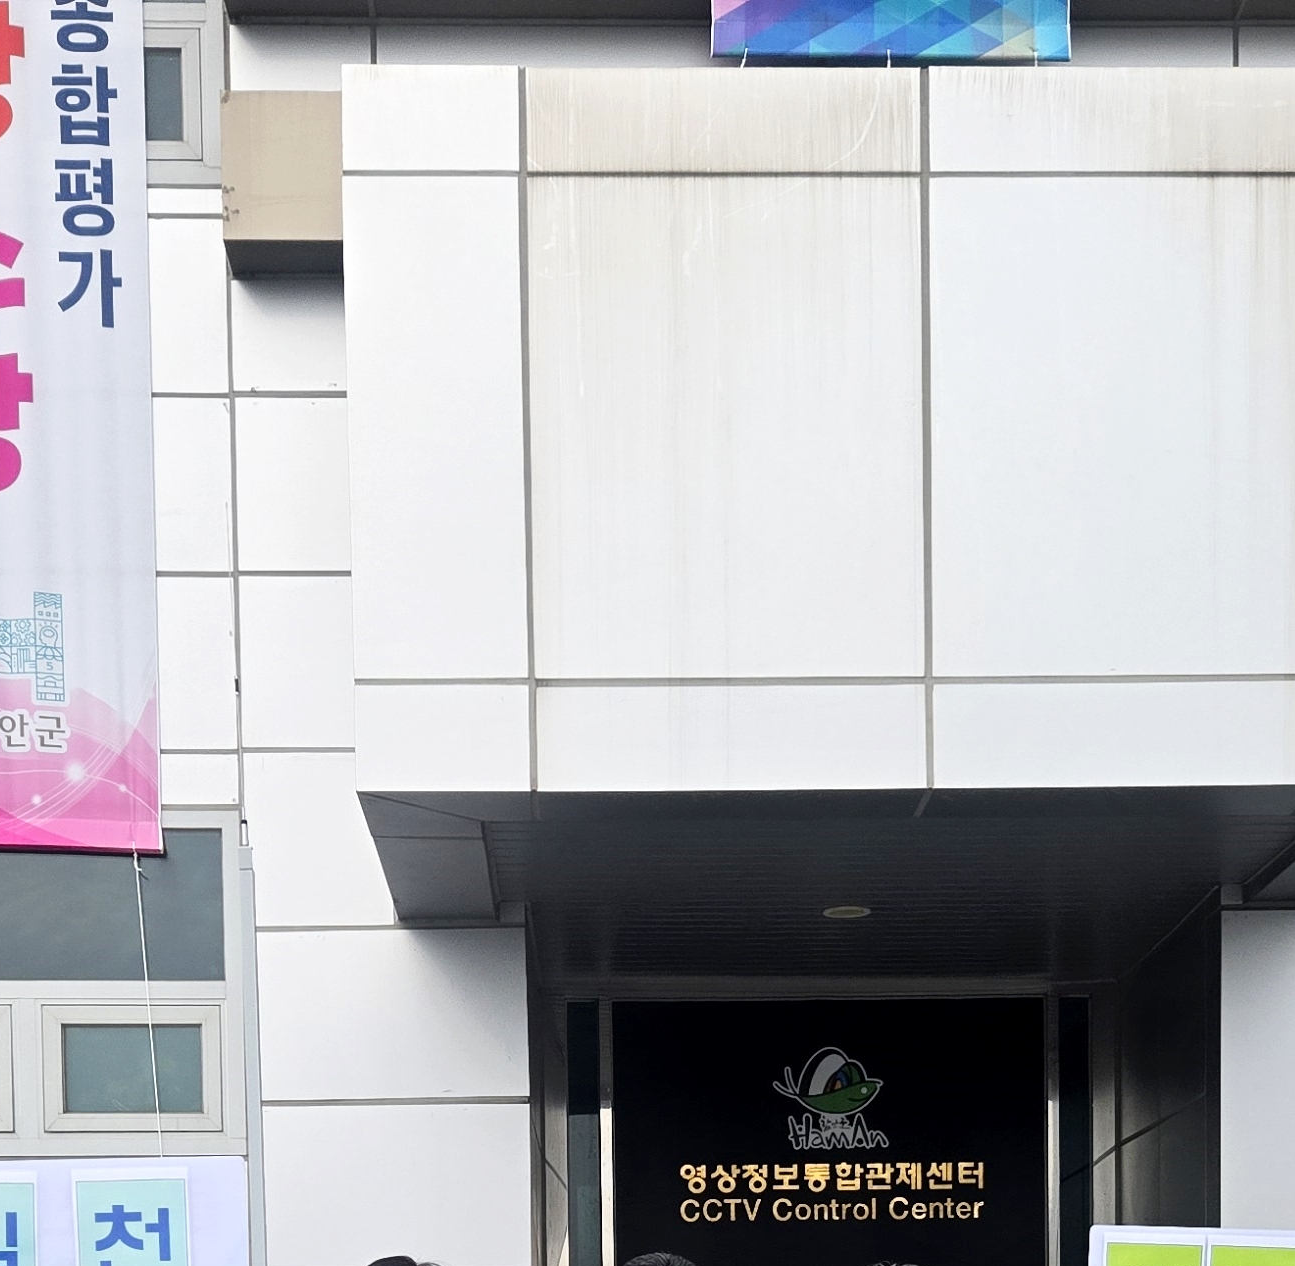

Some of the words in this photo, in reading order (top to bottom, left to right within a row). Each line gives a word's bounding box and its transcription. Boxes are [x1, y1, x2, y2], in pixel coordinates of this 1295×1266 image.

[679, 1161, 984, 1194] 영상정보통합관제센터
[679, 1198, 762, 1222] CCTV
[772, 1198, 877, 1221] Control
[888, 1197, 984, 1221] Center
